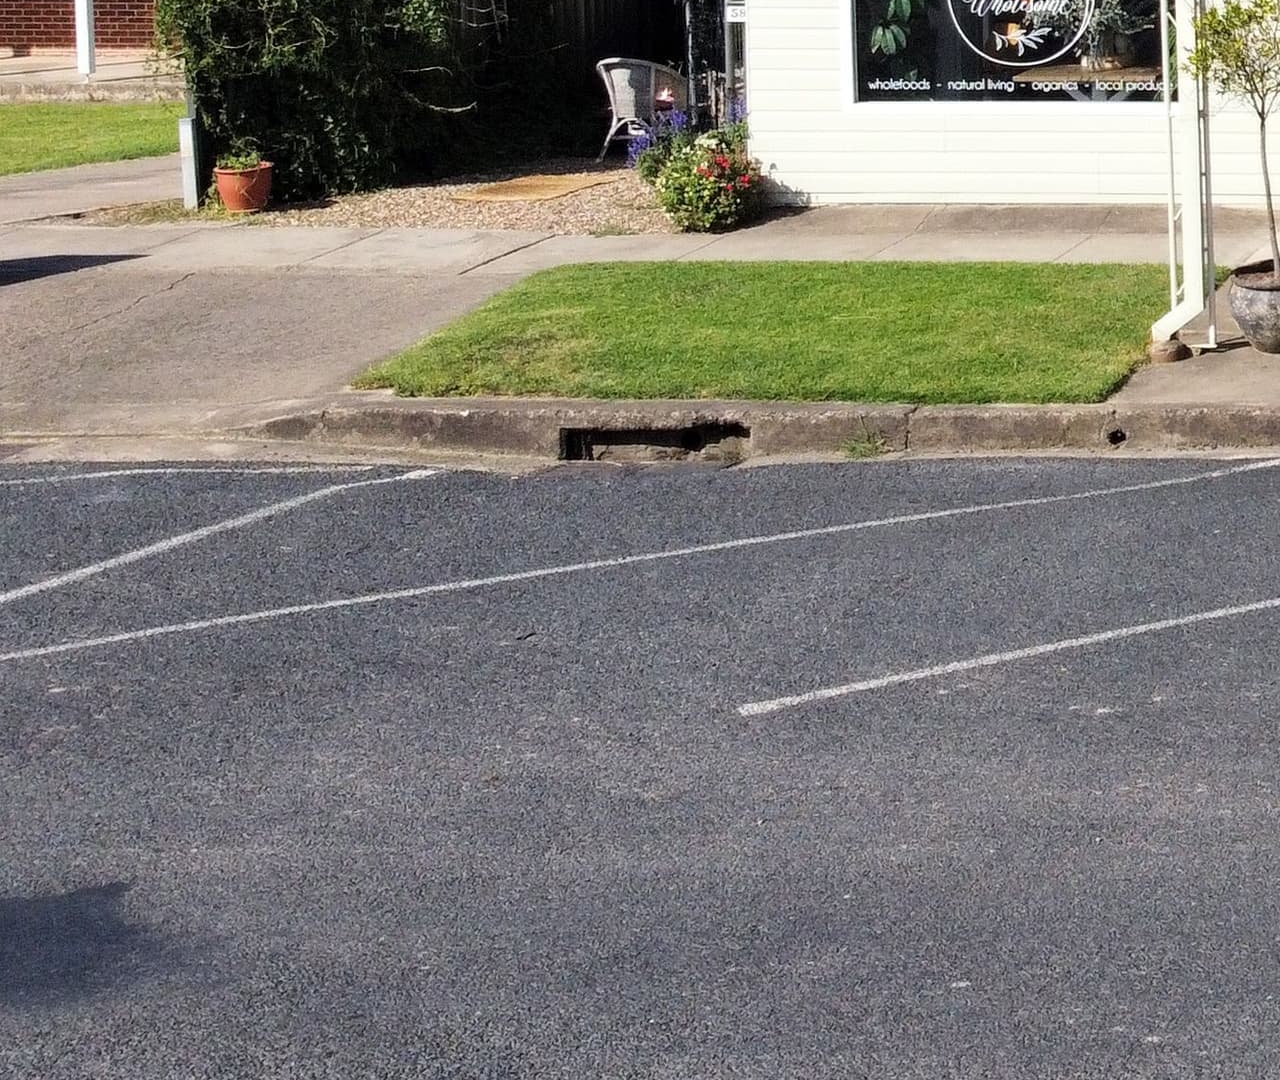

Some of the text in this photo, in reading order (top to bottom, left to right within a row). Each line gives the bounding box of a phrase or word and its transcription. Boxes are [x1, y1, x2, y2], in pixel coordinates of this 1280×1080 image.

[868, 78, 930, 91] wholefoods
[948, 78, 985, 91] natural
[987, 78, 1015, 93] living
[1032, 81, 1078, 93] organics
[1095, 77, 1124, 91] local
[1125, 79, 1174, 94] produc
